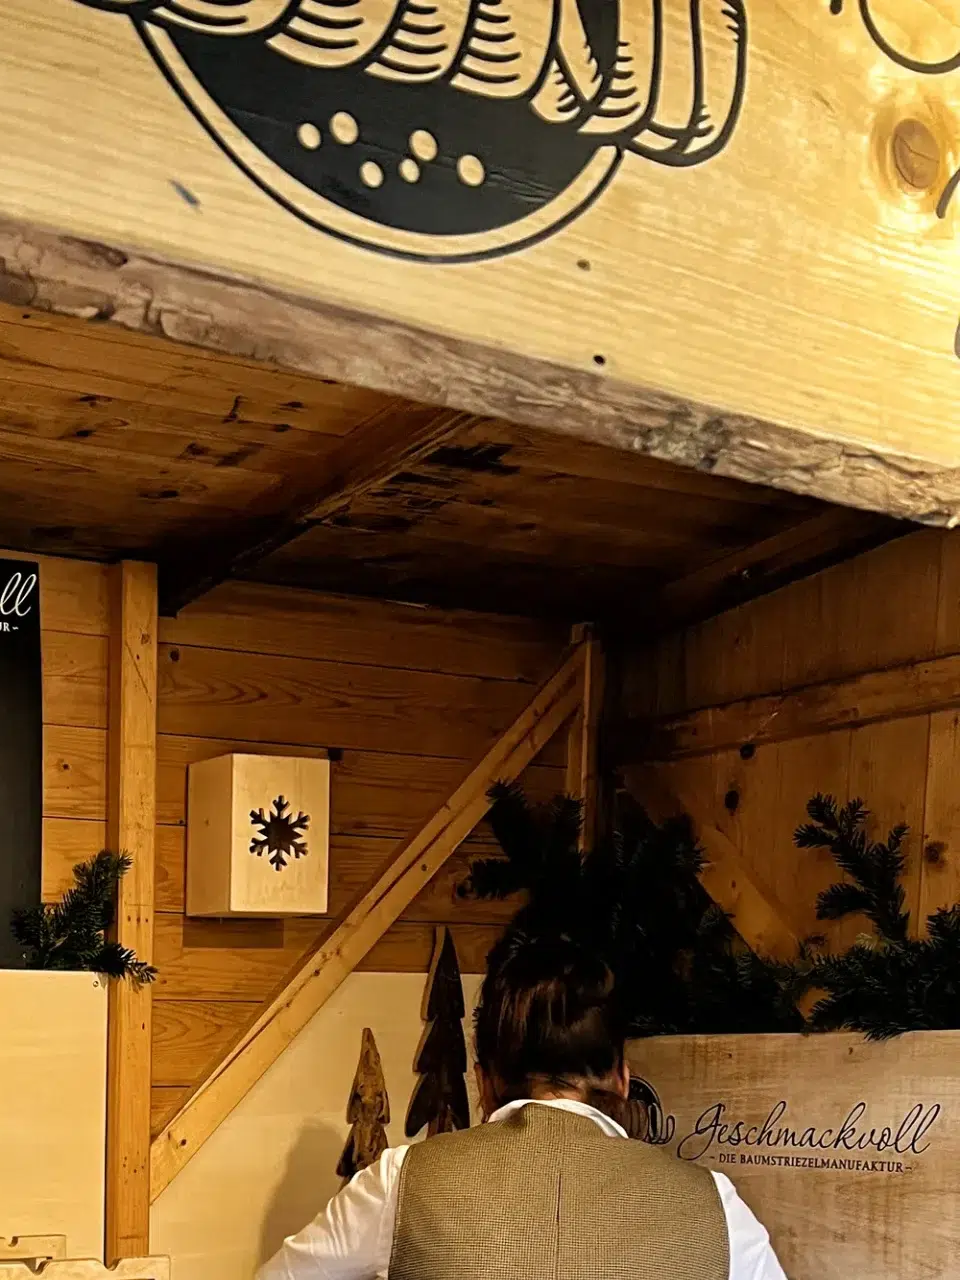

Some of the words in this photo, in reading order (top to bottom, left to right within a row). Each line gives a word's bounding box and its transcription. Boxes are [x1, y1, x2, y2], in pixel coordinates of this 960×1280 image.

[677, 1101, 941, 1161] Geschmackvoll
[719, 1153, 737, 1164] DIE
[740, 1154, 904, 1173] BAUMSTRIEZELMANUFAKTUR
